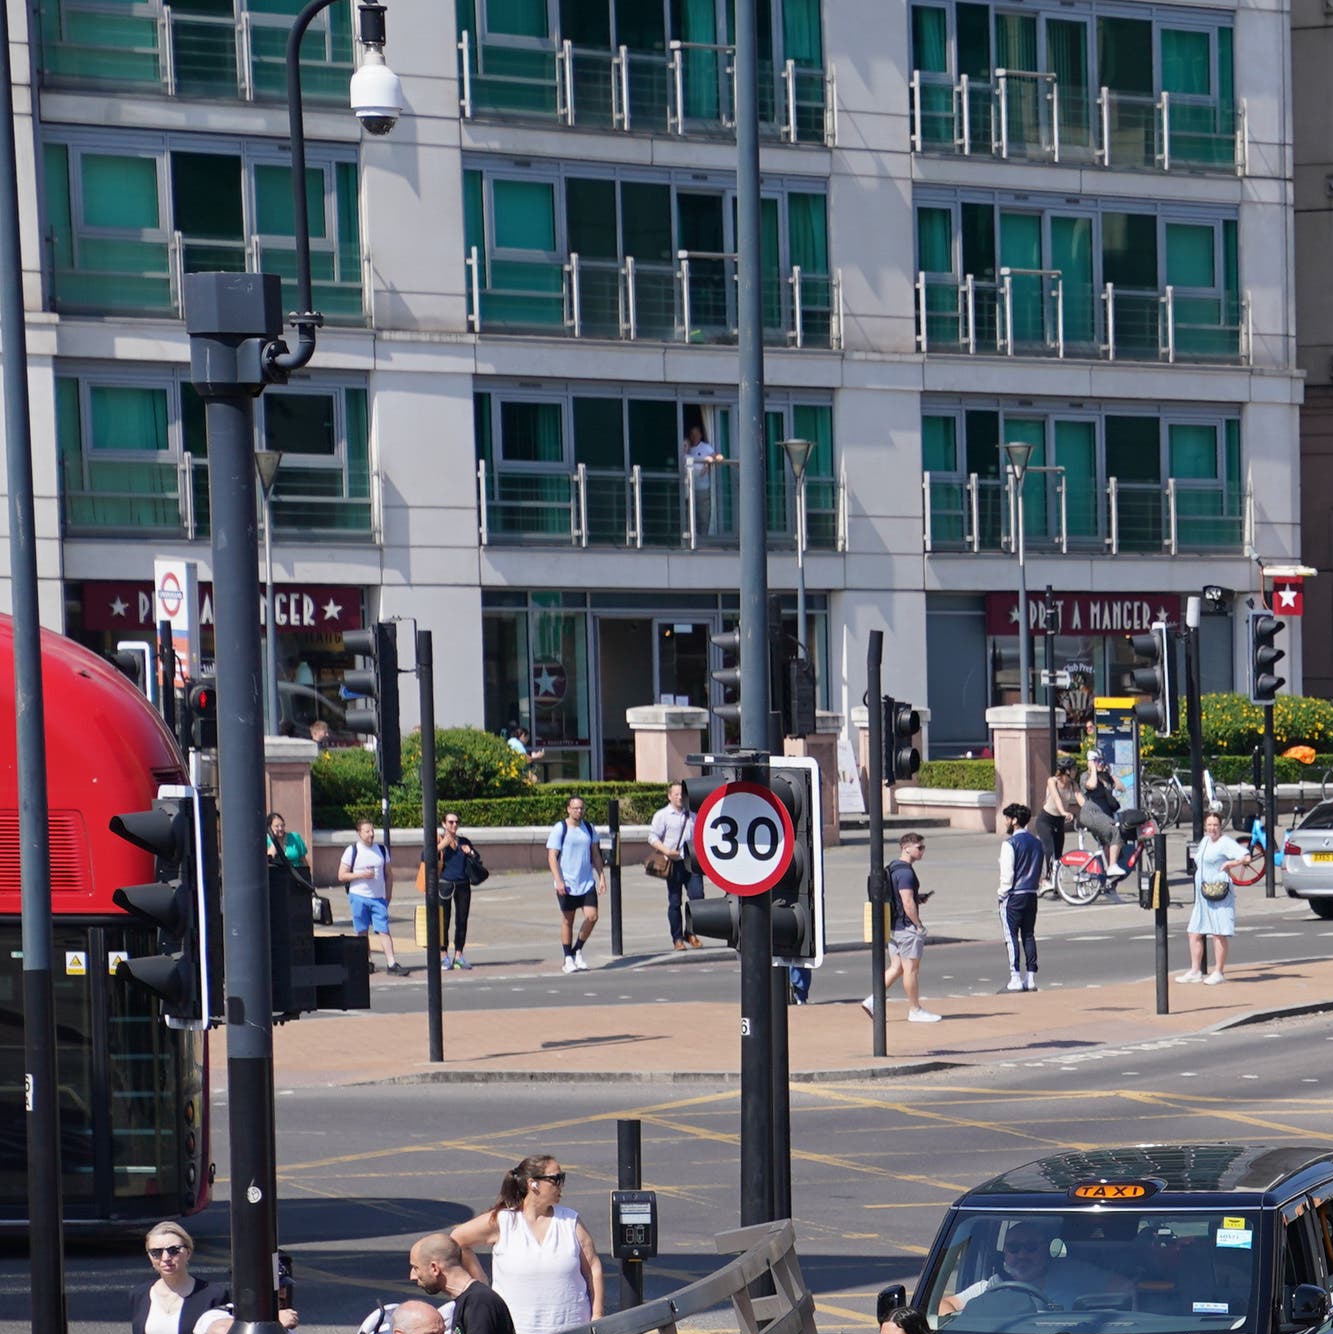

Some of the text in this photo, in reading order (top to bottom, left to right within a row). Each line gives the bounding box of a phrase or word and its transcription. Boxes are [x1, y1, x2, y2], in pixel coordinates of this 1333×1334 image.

[1030, 599, 1151, 631] PRT A MANGER
[710, 815, 779, 861] 30
[1082, 1186, 1139, 1197] TAXI
